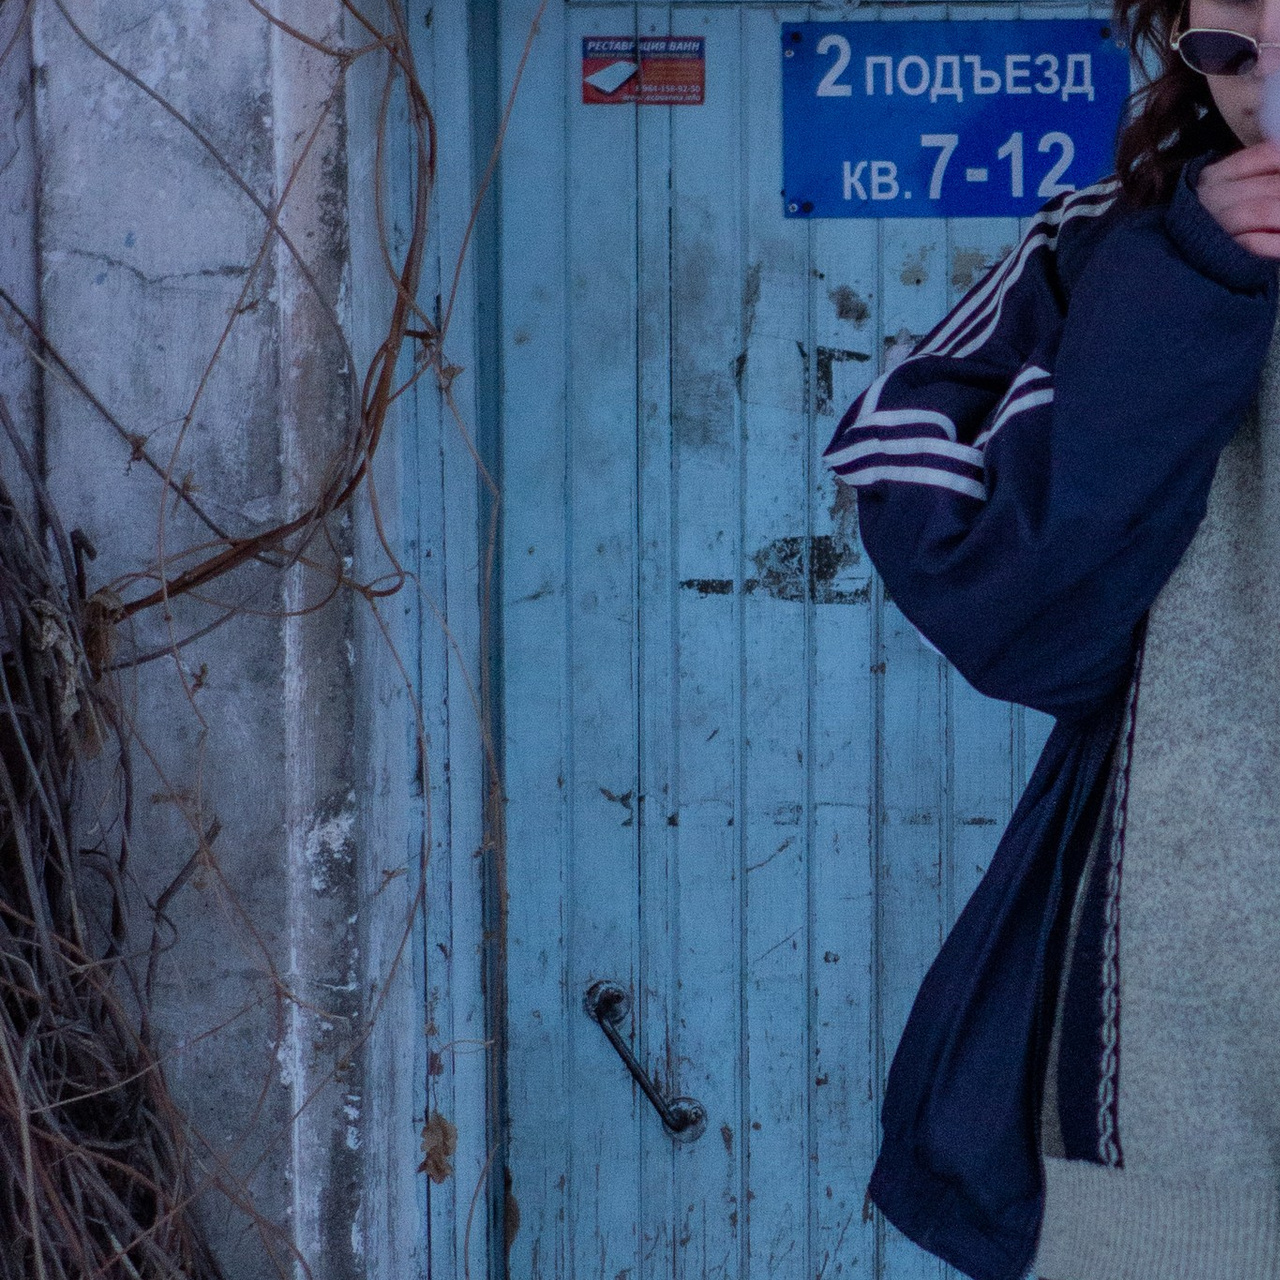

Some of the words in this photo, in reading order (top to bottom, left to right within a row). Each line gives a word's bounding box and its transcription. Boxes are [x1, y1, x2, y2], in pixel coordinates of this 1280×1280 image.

[587, 42, 666, 51] РЕСТАВРЦИЯ
[669, 42, 700, 51] ВАНН
[816, 34, 853, 97] 2
[865, 54, 1095, 102] ПОДЪЕЗД
[843, 160, 912, 201] КВ.
[920, 131, 1076, 199] 7-12
